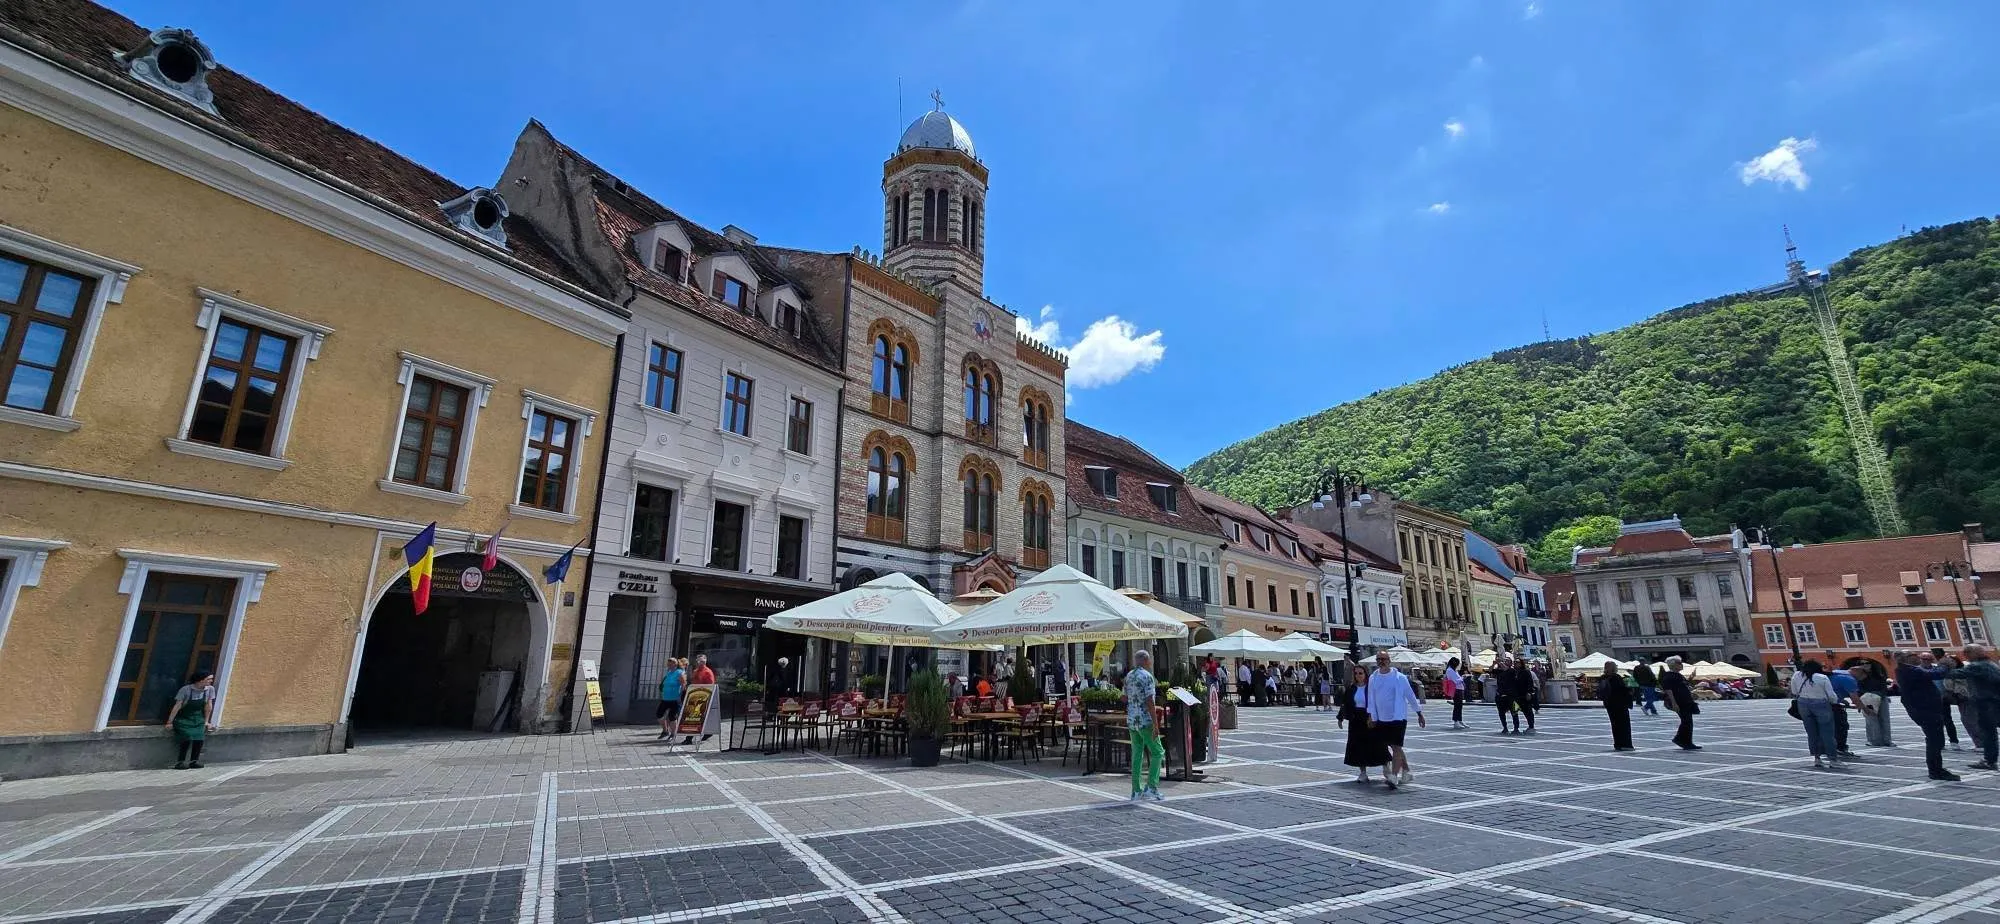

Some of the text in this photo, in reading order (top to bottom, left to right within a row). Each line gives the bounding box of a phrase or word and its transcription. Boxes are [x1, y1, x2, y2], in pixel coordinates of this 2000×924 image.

[619, 570, 659, 582] Brauhaus
[618, 581, 657, 593] CZELL
[754, 598, 786, 609] PANNER
[845, 622, 869, 630] gustul
[869, 624, 901, 633] pierdut!
[1014, 624, 1041, 634] gustul
[1042, 622, 1077, 633] pierdut!
